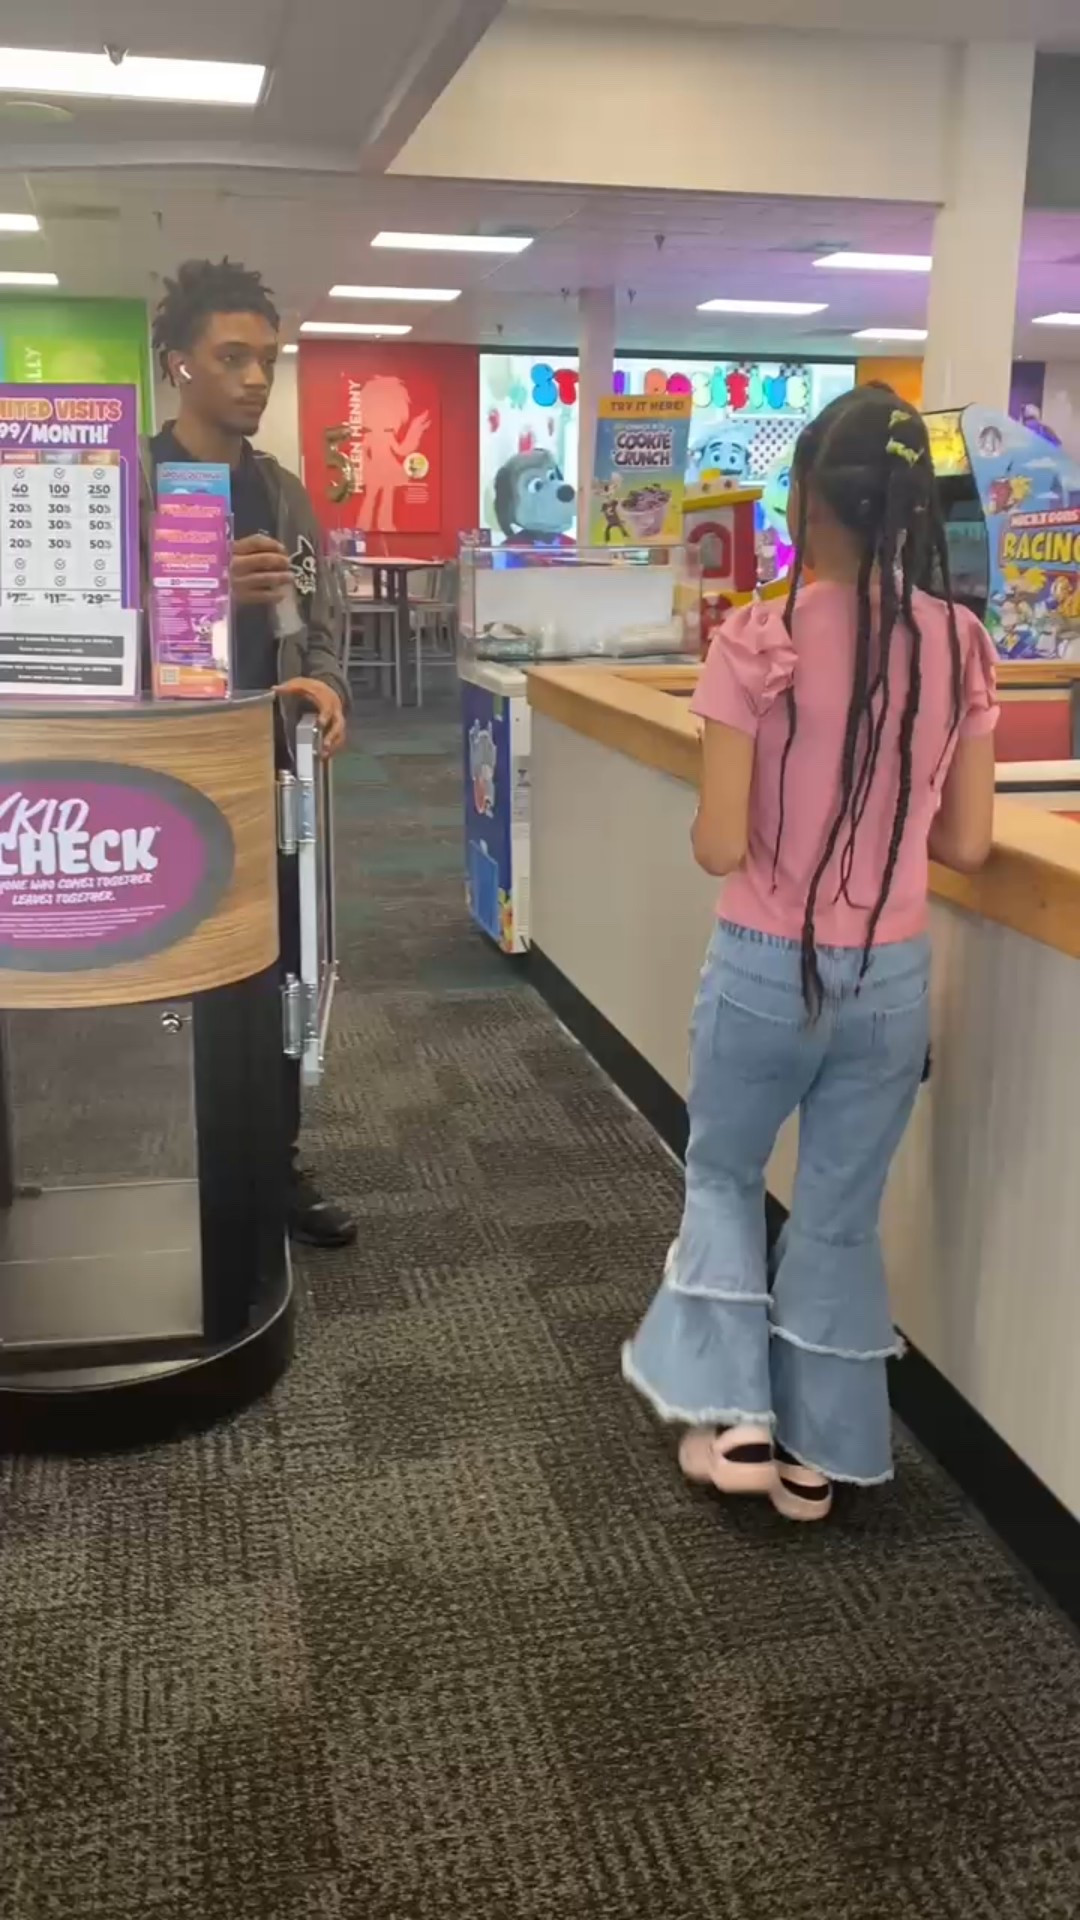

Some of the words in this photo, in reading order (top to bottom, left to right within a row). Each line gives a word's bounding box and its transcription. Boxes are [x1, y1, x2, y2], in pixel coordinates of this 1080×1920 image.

[24, 347, 42, 382] LLY
[54, 398, 122, 421] VISITS
[348, 379, 362, 438] HENNY
[611, 401, 632, 411] TRY
[635, 401, 648, 411] IT
[617, 433, 671, 450] COOKIE
[614, 451, 670, 466] CRUNCH
[12, 484, 29, 493] 40
[49, 484, 70, 493] 100
[88, 484, 111, 494] 250
[0, 827, 158, 875] CHECK
[31, 880, 54, 890] WHO
[57, 878, 93, 889] COMES
[97, 873, 152, 887] TOGETHER
[12, 893, 52, 905] LEAVES
